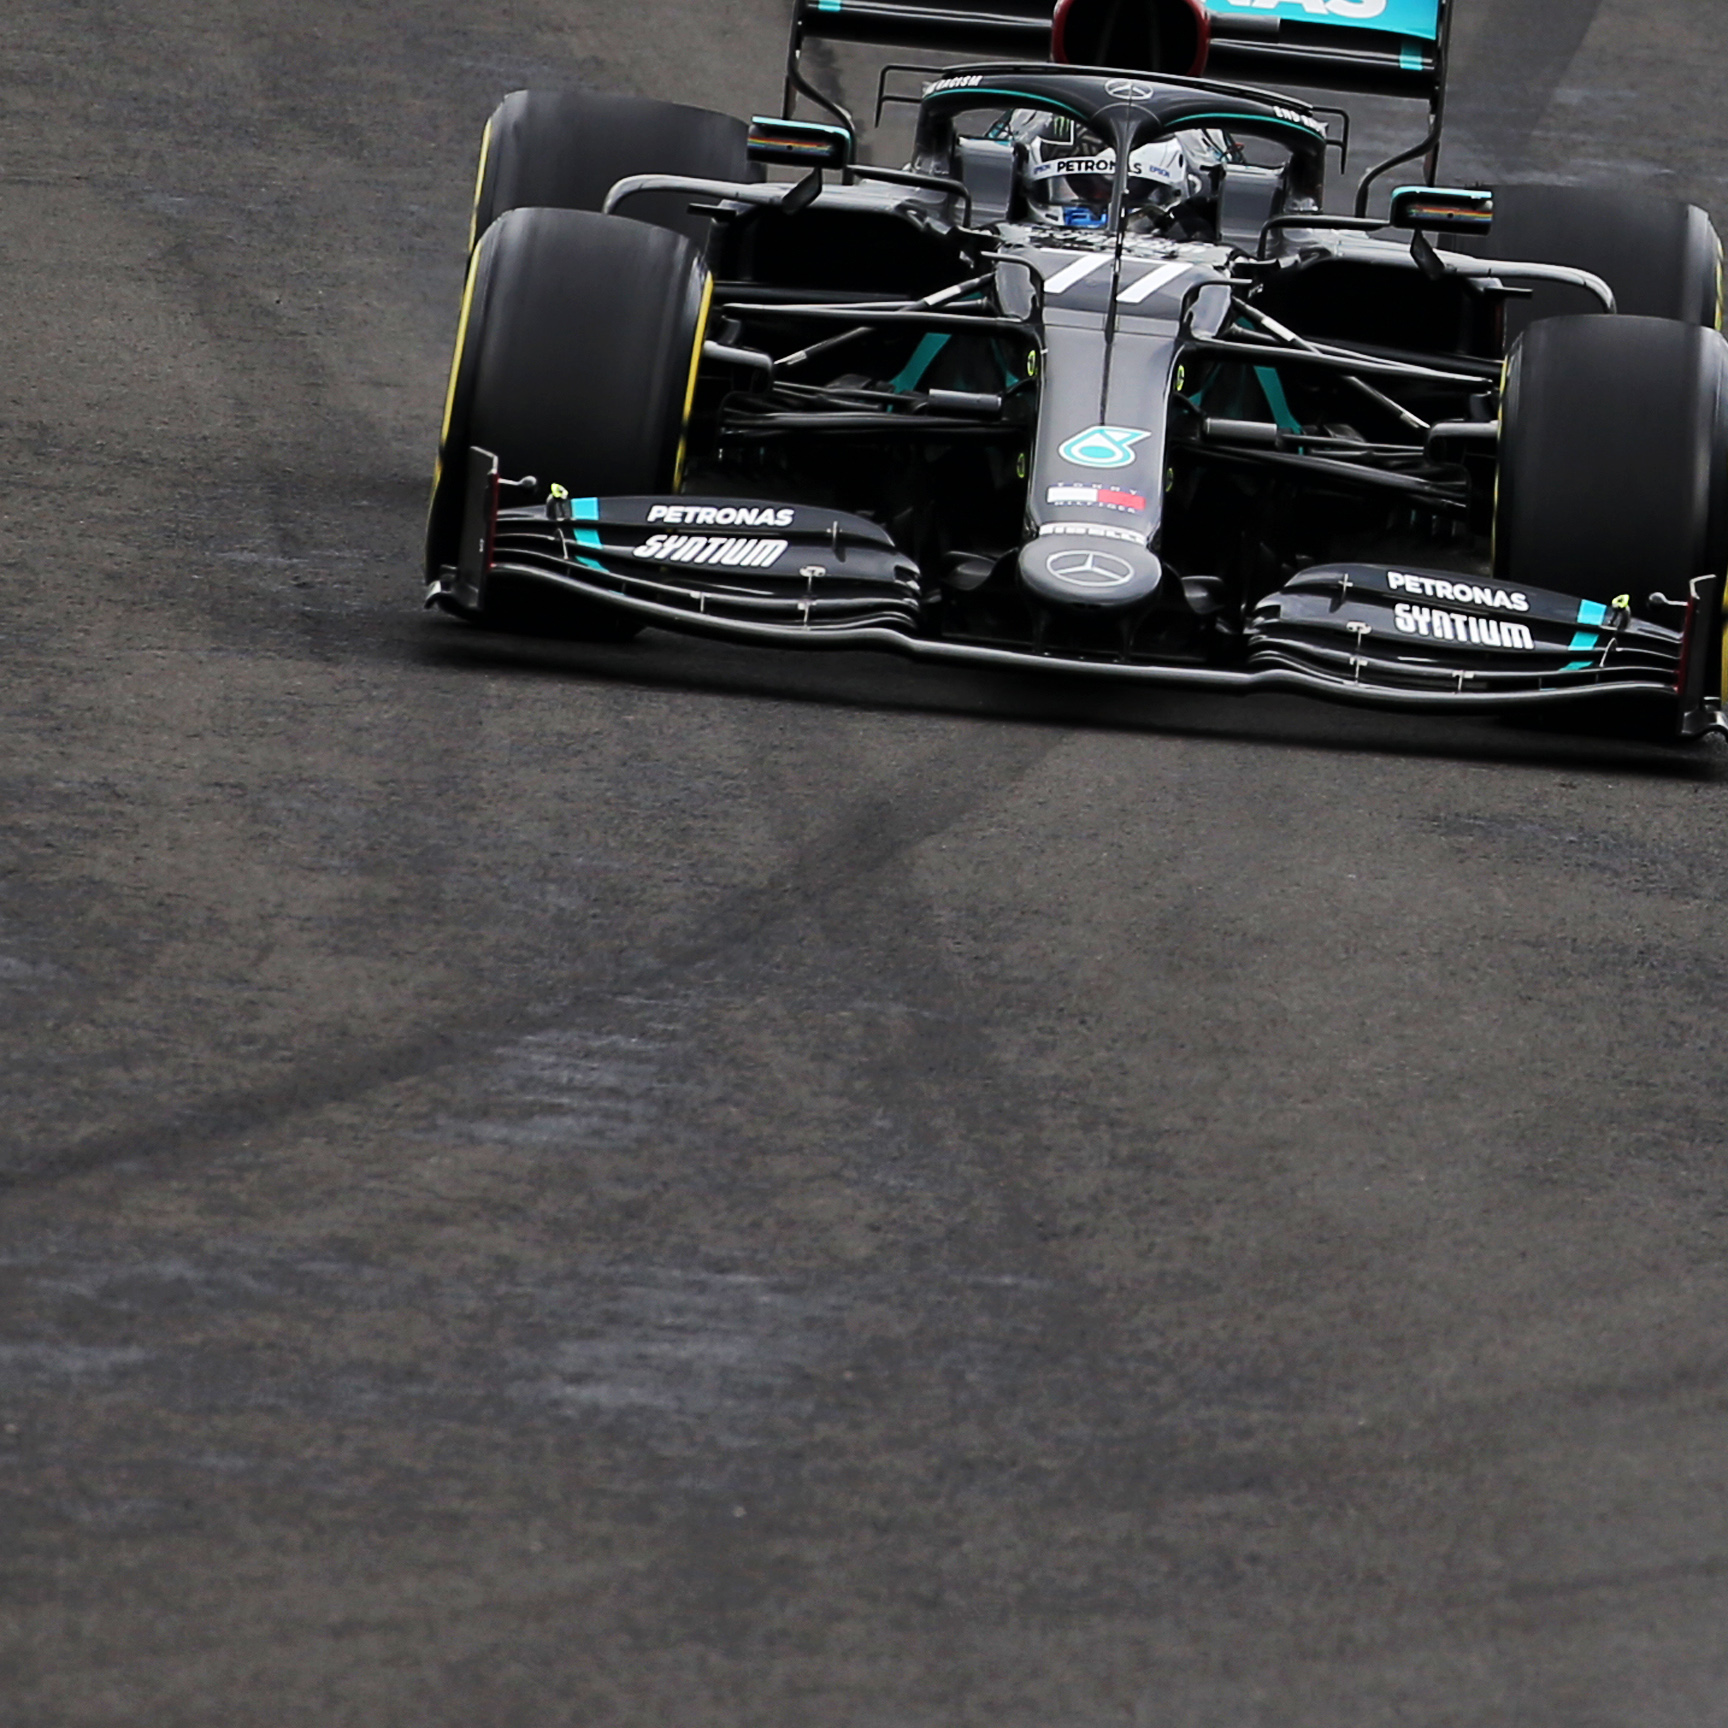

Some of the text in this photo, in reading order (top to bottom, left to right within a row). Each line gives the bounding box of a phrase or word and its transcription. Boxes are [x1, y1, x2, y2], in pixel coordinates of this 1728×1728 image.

[647, 505, 795, 527] PETRONAS
[633, 534, 788, 568] SYNTIUM
[1387, 571, 1530, 612] PETRONAS
[1394, 602, 1535, 650] SYNTIUM
